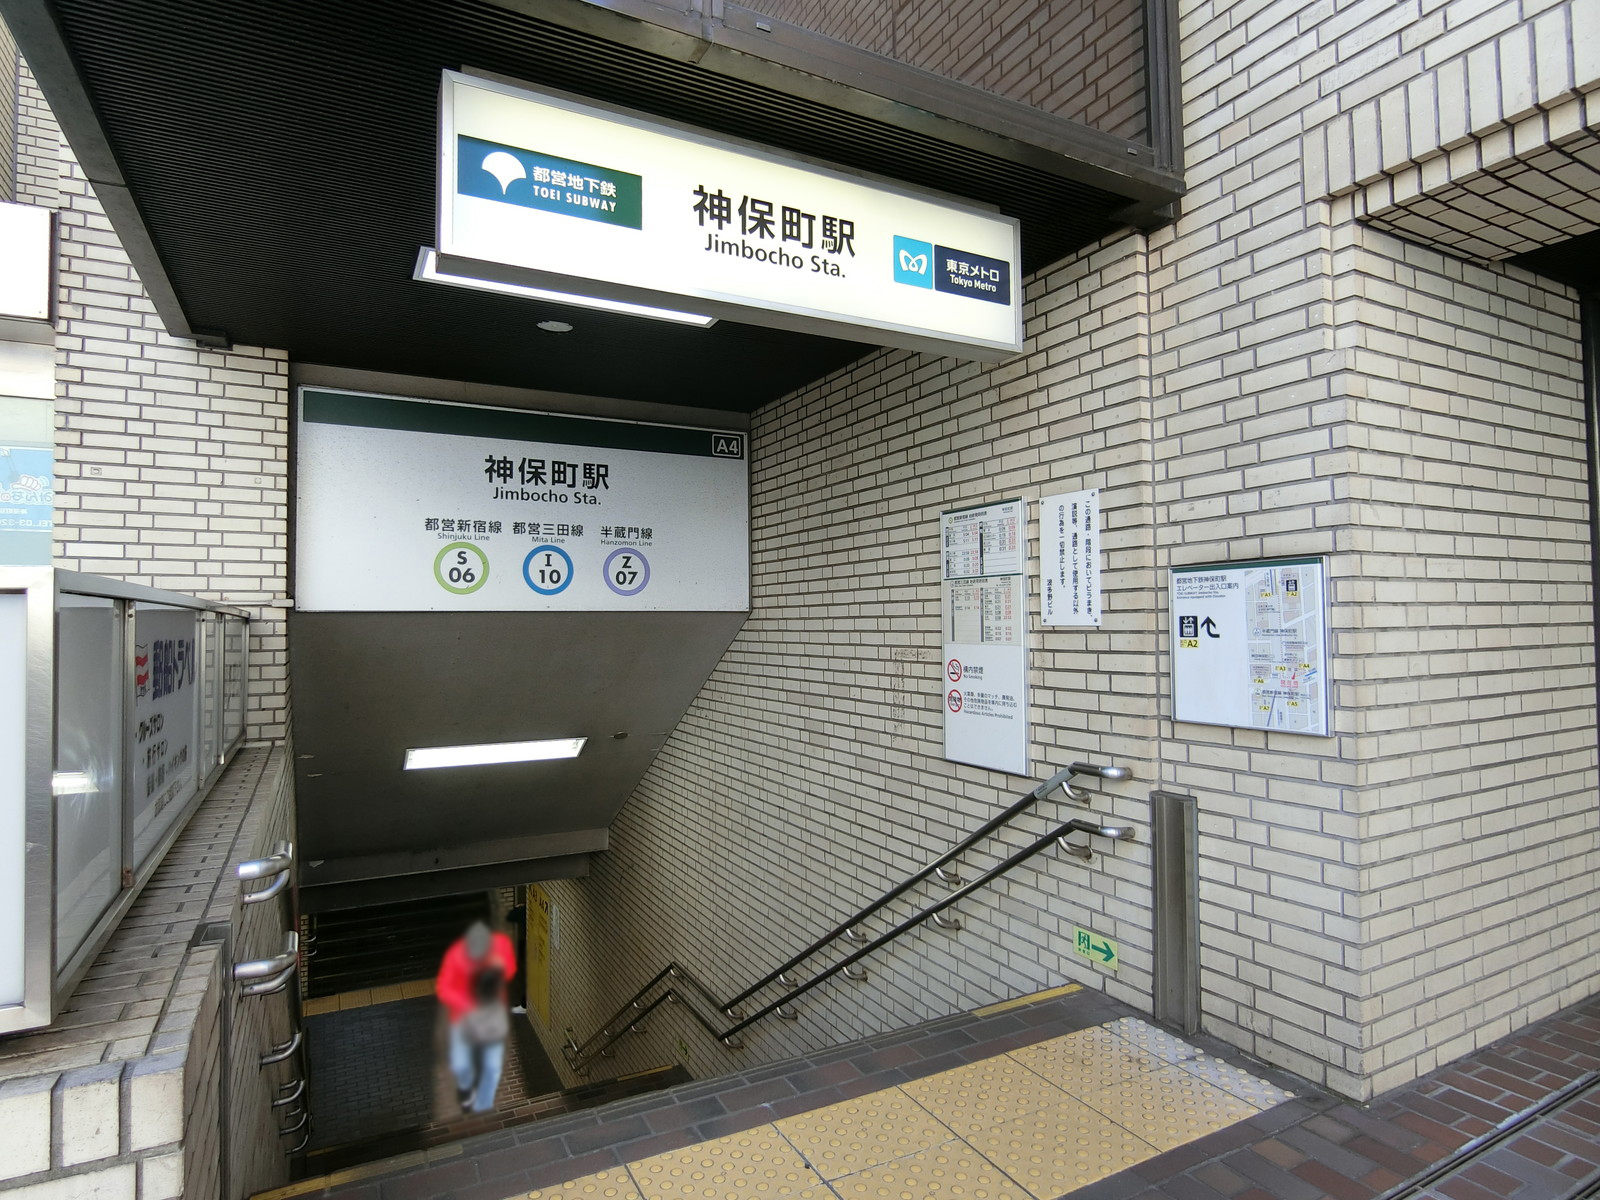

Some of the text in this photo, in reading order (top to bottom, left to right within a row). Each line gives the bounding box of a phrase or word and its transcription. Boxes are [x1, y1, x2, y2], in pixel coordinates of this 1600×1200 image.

[533, 165, 617, 199] 都営地下鉄
[533, 184, 618, 214] TOEI SUBWAY
[693, 185, 856, 257] 神保町駅
[704, 233, 847, 279] Jimbocho Sta.
[946, 258, 1001, 283] 東京メトロ
[950, 274, 998, 293] Tokyo Metro
[716, 435, 739, 455] A4
[484, 454, 610, 490] 神保町駅
[492, 486, 602, 506] Jimbocho Sta.
[424, 517, 503, 535] 都営新宿線
[512, 521, 584, 538] 都営三田線
[600, 525, 653, 540] 半蔵門線
[437, 532, 490, 542] Shinjuku Line
[531, 535, 565, 544] Mita Line
[600, 538, 653, 547] Hanzomon Line
[457, 550, 468, 566] S
[544, 553, 553, 568] I
[621, 556, 632, 569] Z
[448, 566, 476, 584] 06
[539, 569, 561, 584] 10
[615, 570, 639, 586] 07
[1187, 640, 1198, 648] A2
